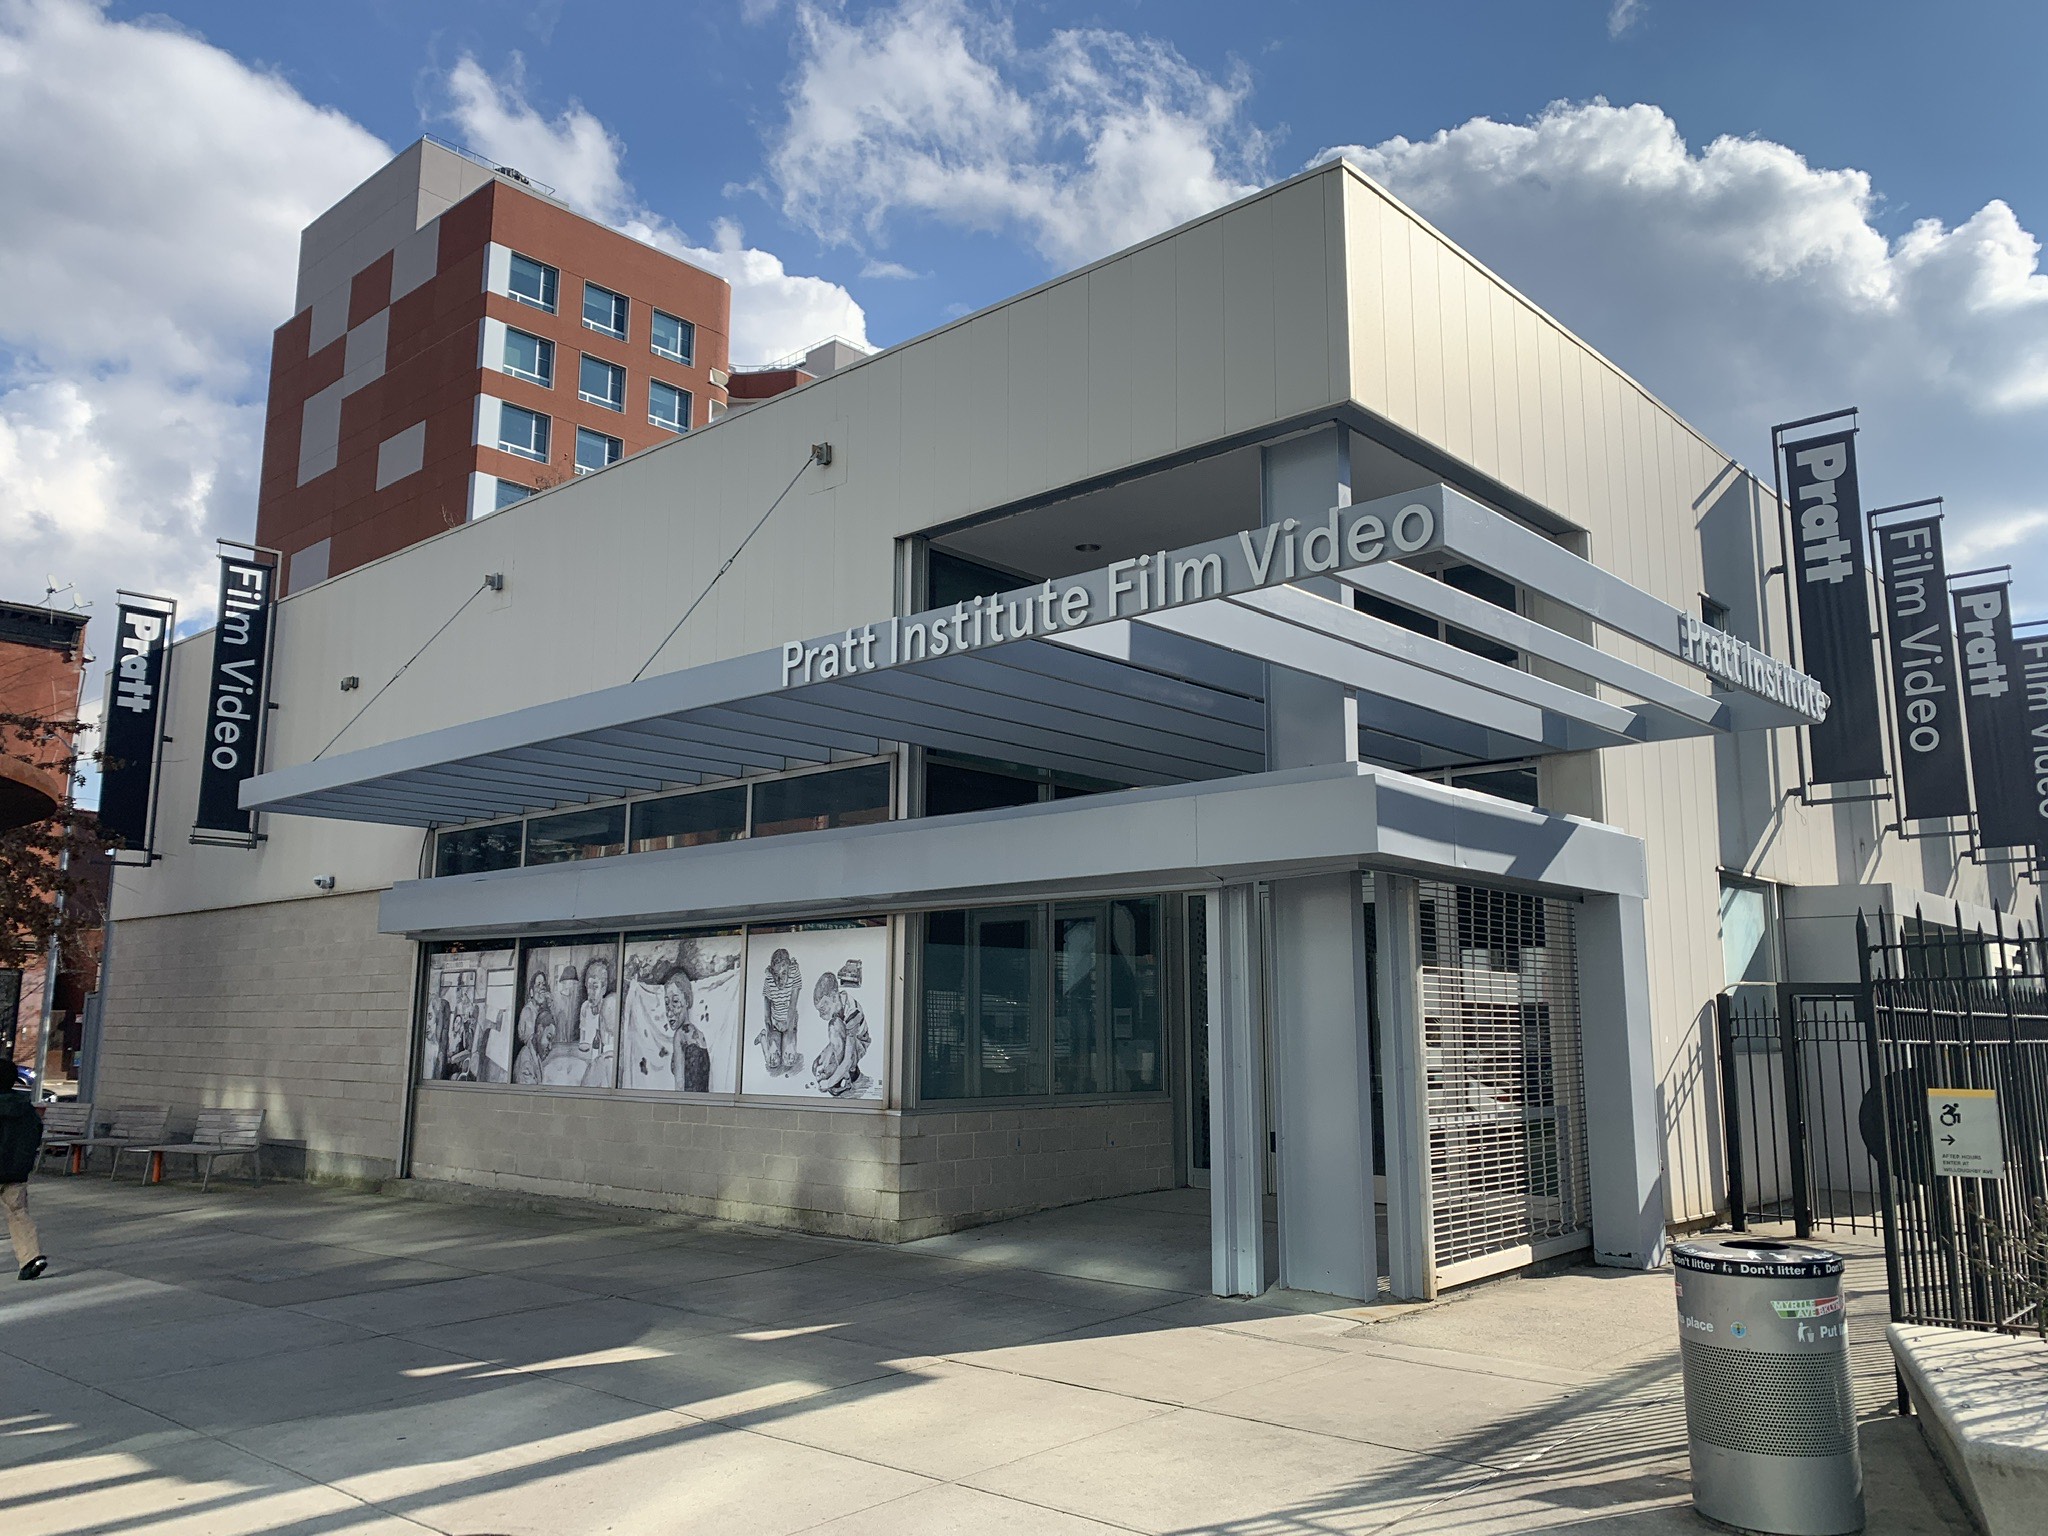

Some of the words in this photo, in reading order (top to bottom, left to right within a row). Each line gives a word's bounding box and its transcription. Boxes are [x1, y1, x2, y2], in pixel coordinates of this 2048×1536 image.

[1796, 441, 1854, 584] Pratt
[223, 564, 264, 645] Film
[781, 623, 876, 686] Pratt
[890, 578, 1089, 664] Institute
[1108, 550, 1222, 617] Film
[1238, 504, 1434, 586] Video
[1890, 525, 1934, 618] Film
[116, 612, 162, 713] Pratt
[1686, 610, 1742, 683] Pratt
[1745, 641, 1830, 722] Institute
[1900, 623, 1946, 752] Video
[1960, 590, 2010, 698] Pratt
[211, 659, 256, 770] Video
[1691, 1258, 1715, 1271] litter
[1740, 1264, 1774, 1275] Don't
[1777, 1265, 1806, 1276] litter
[1773, 1300, 1815, 1309] MYRTLE
[1686, 1316, 1714, 1332] place
[1820, 1324, 1838, 1338] Put
